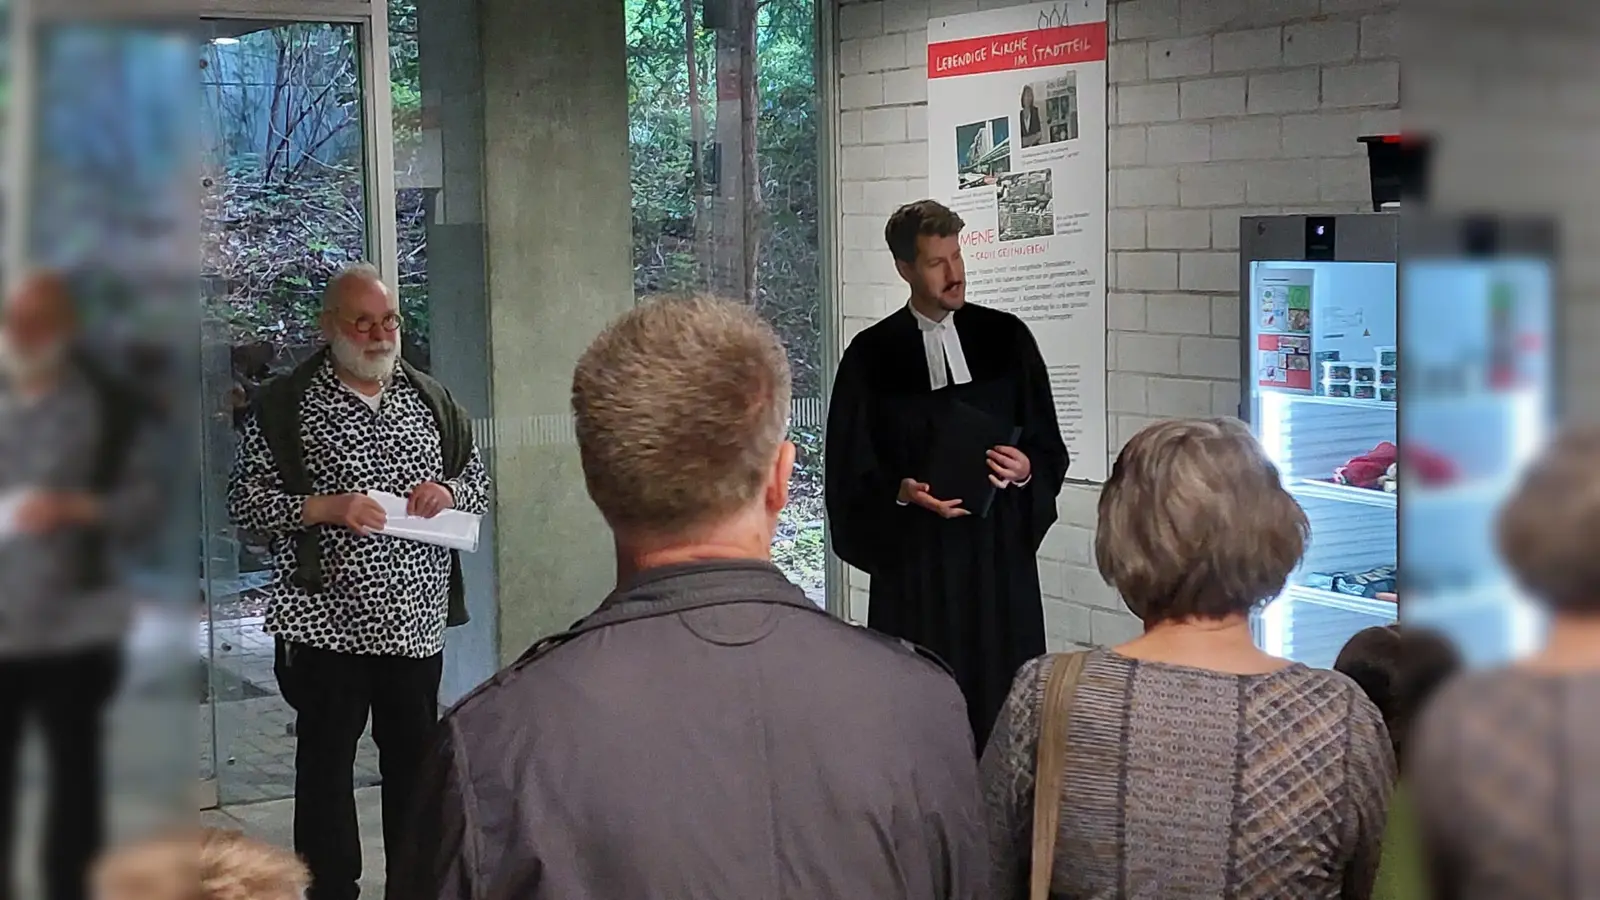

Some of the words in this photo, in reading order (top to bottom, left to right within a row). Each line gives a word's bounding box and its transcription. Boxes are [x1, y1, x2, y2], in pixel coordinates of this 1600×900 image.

[936, 47, 988, 72] LEBENDIGE
[991, 36, 1029, 57] KIRCHE
[1014, 54, 1029, 66] IM
[1031, 37, 1092, 63] STADTTEIL
[960, 229, 995, 246] MENE
